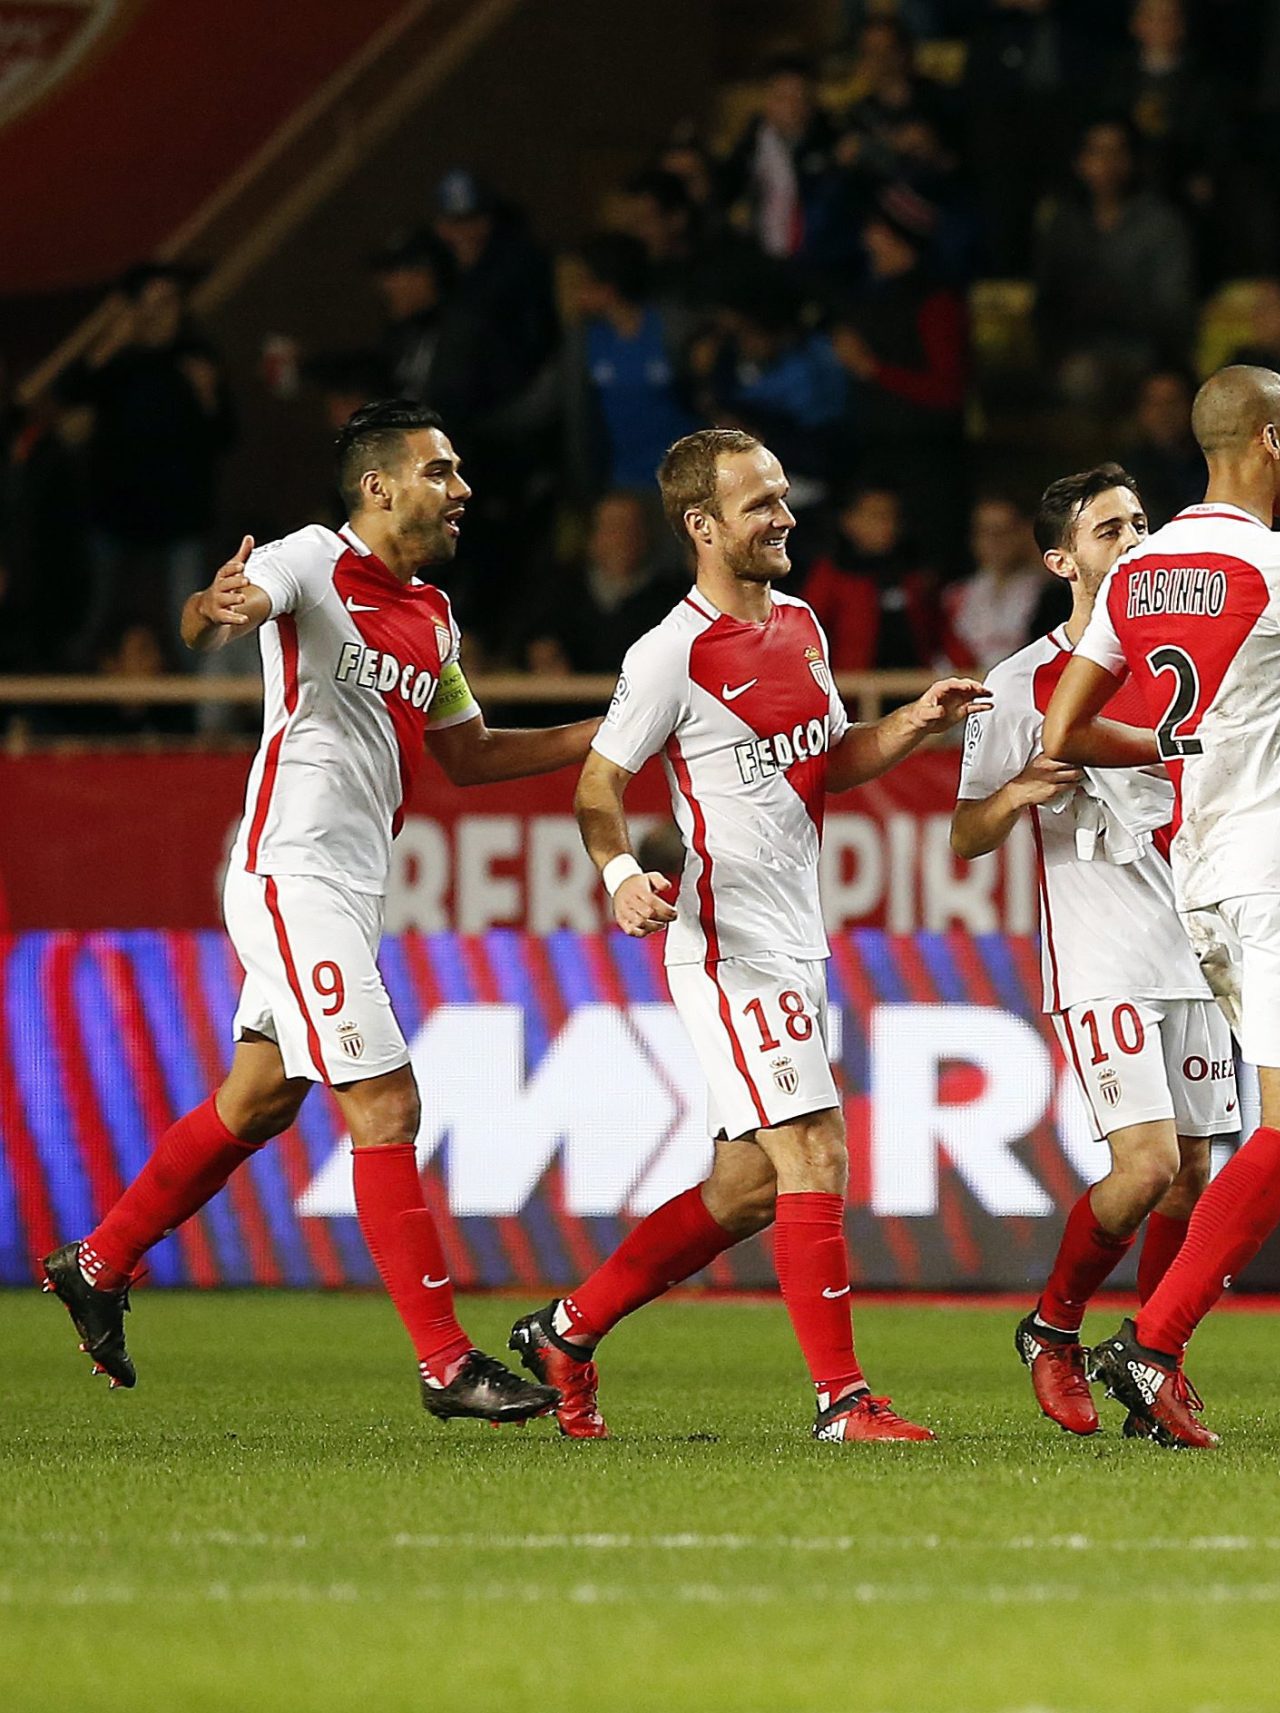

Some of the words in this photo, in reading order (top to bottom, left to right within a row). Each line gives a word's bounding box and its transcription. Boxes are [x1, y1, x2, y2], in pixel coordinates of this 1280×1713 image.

[1127, 568, 1227, 619] FABINHO
[1145, 644, 1206, 761] 2
[311, 960, 345, 1016] 9
[742, 990, 813, 1053] 18
[1080, 1003, 1145, 1066] 10
